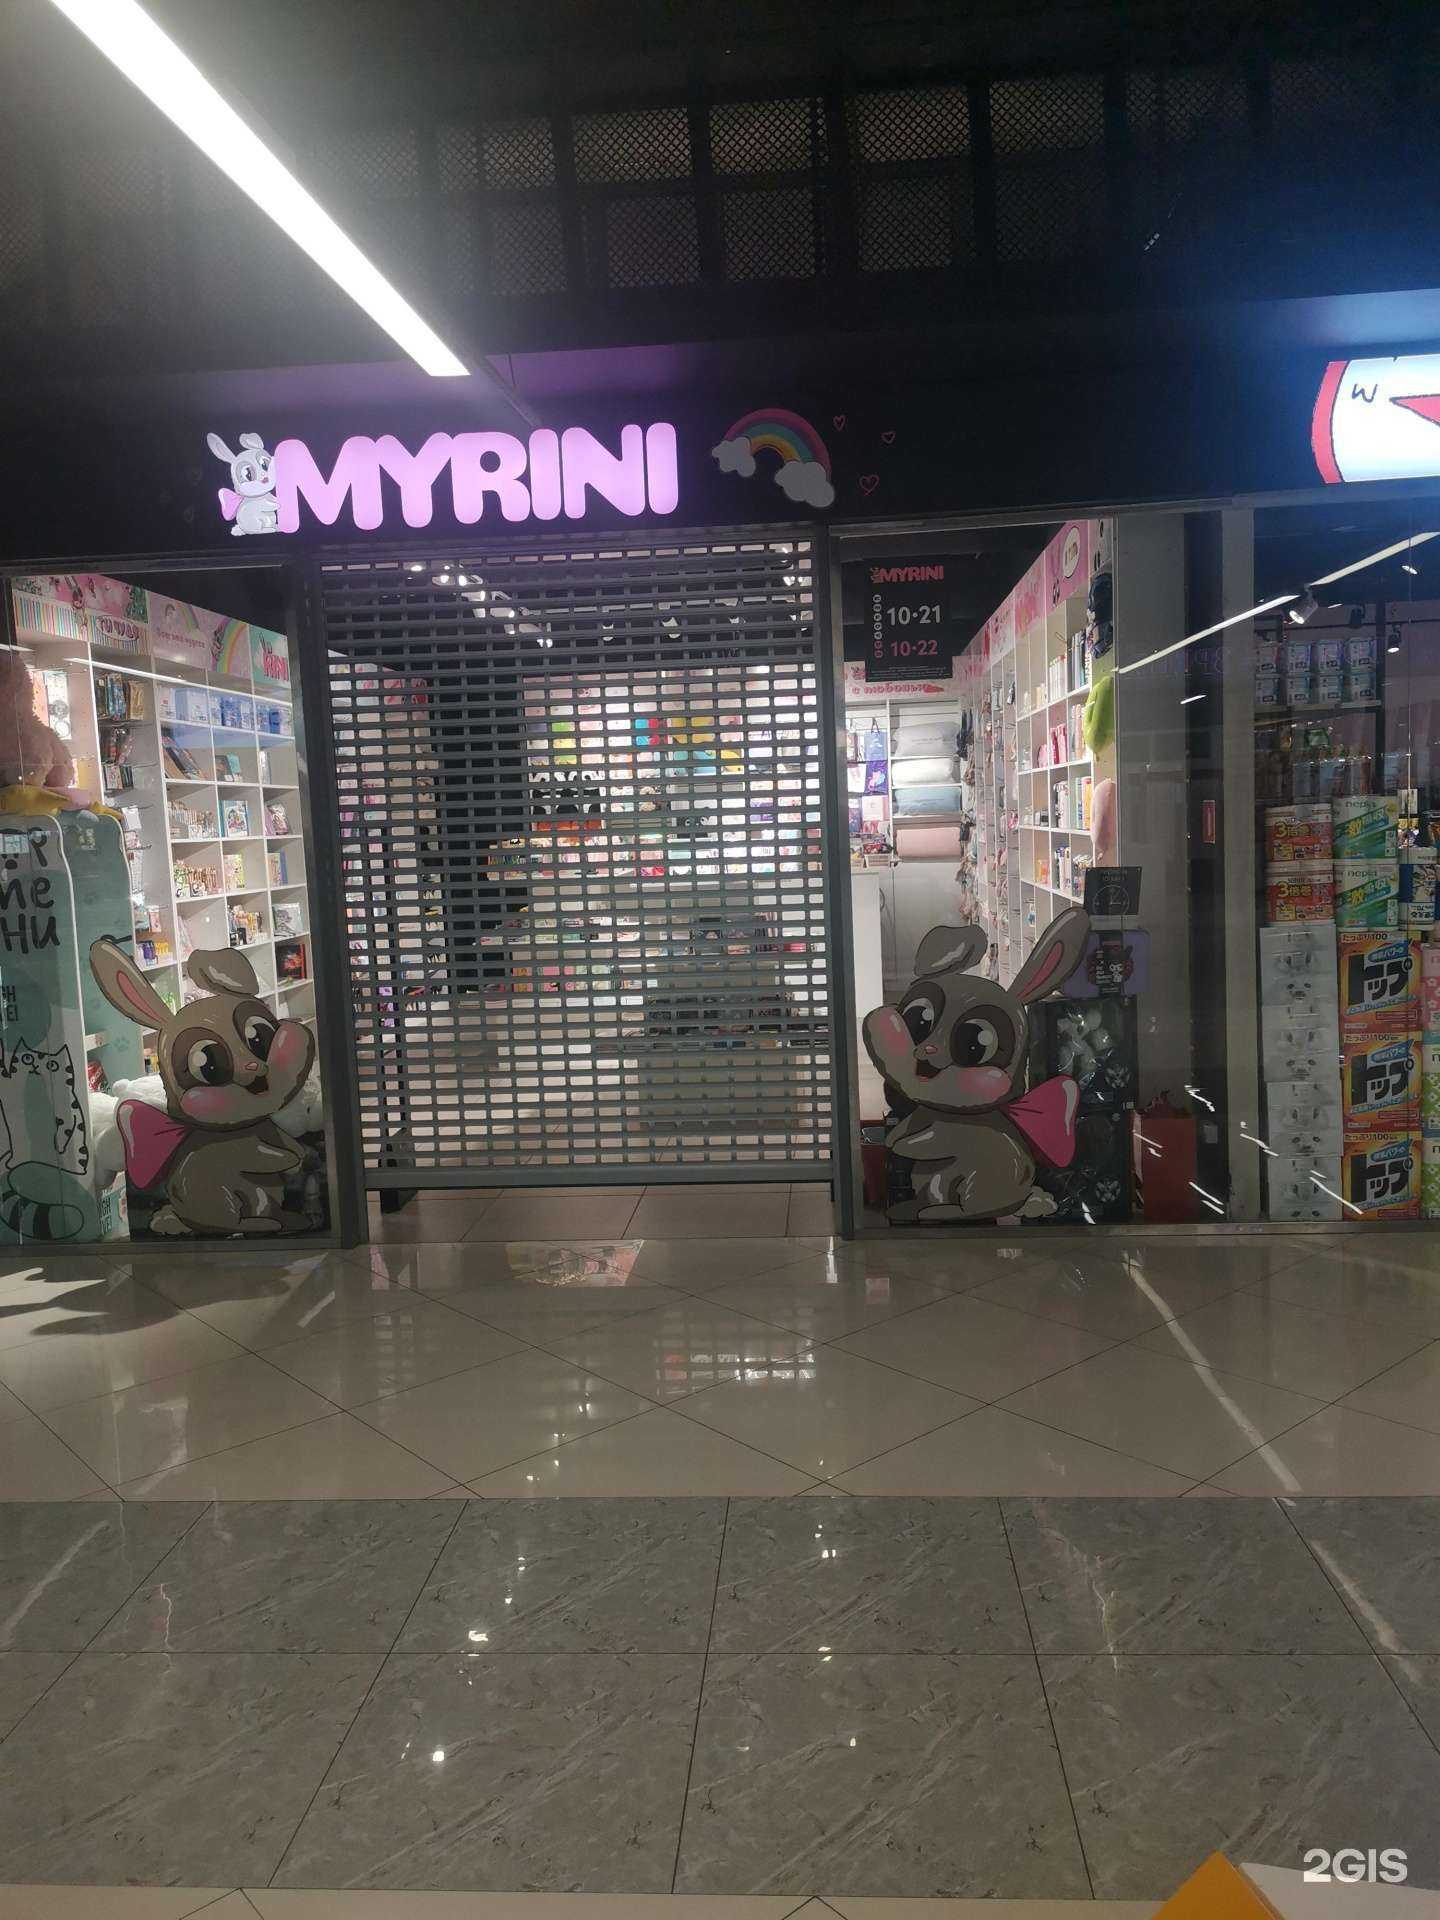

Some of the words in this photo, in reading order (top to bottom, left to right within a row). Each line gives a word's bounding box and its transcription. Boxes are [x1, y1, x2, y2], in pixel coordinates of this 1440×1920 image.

[274, 422, 679, 534] MYRINI
[878, 565, 945, 583] MYRINI
[1348, 953, 1414, 1005] トップ
[1350, 1054, 1414, 1105] トップ
[1350, 1153, 1414, 1203] トップ
